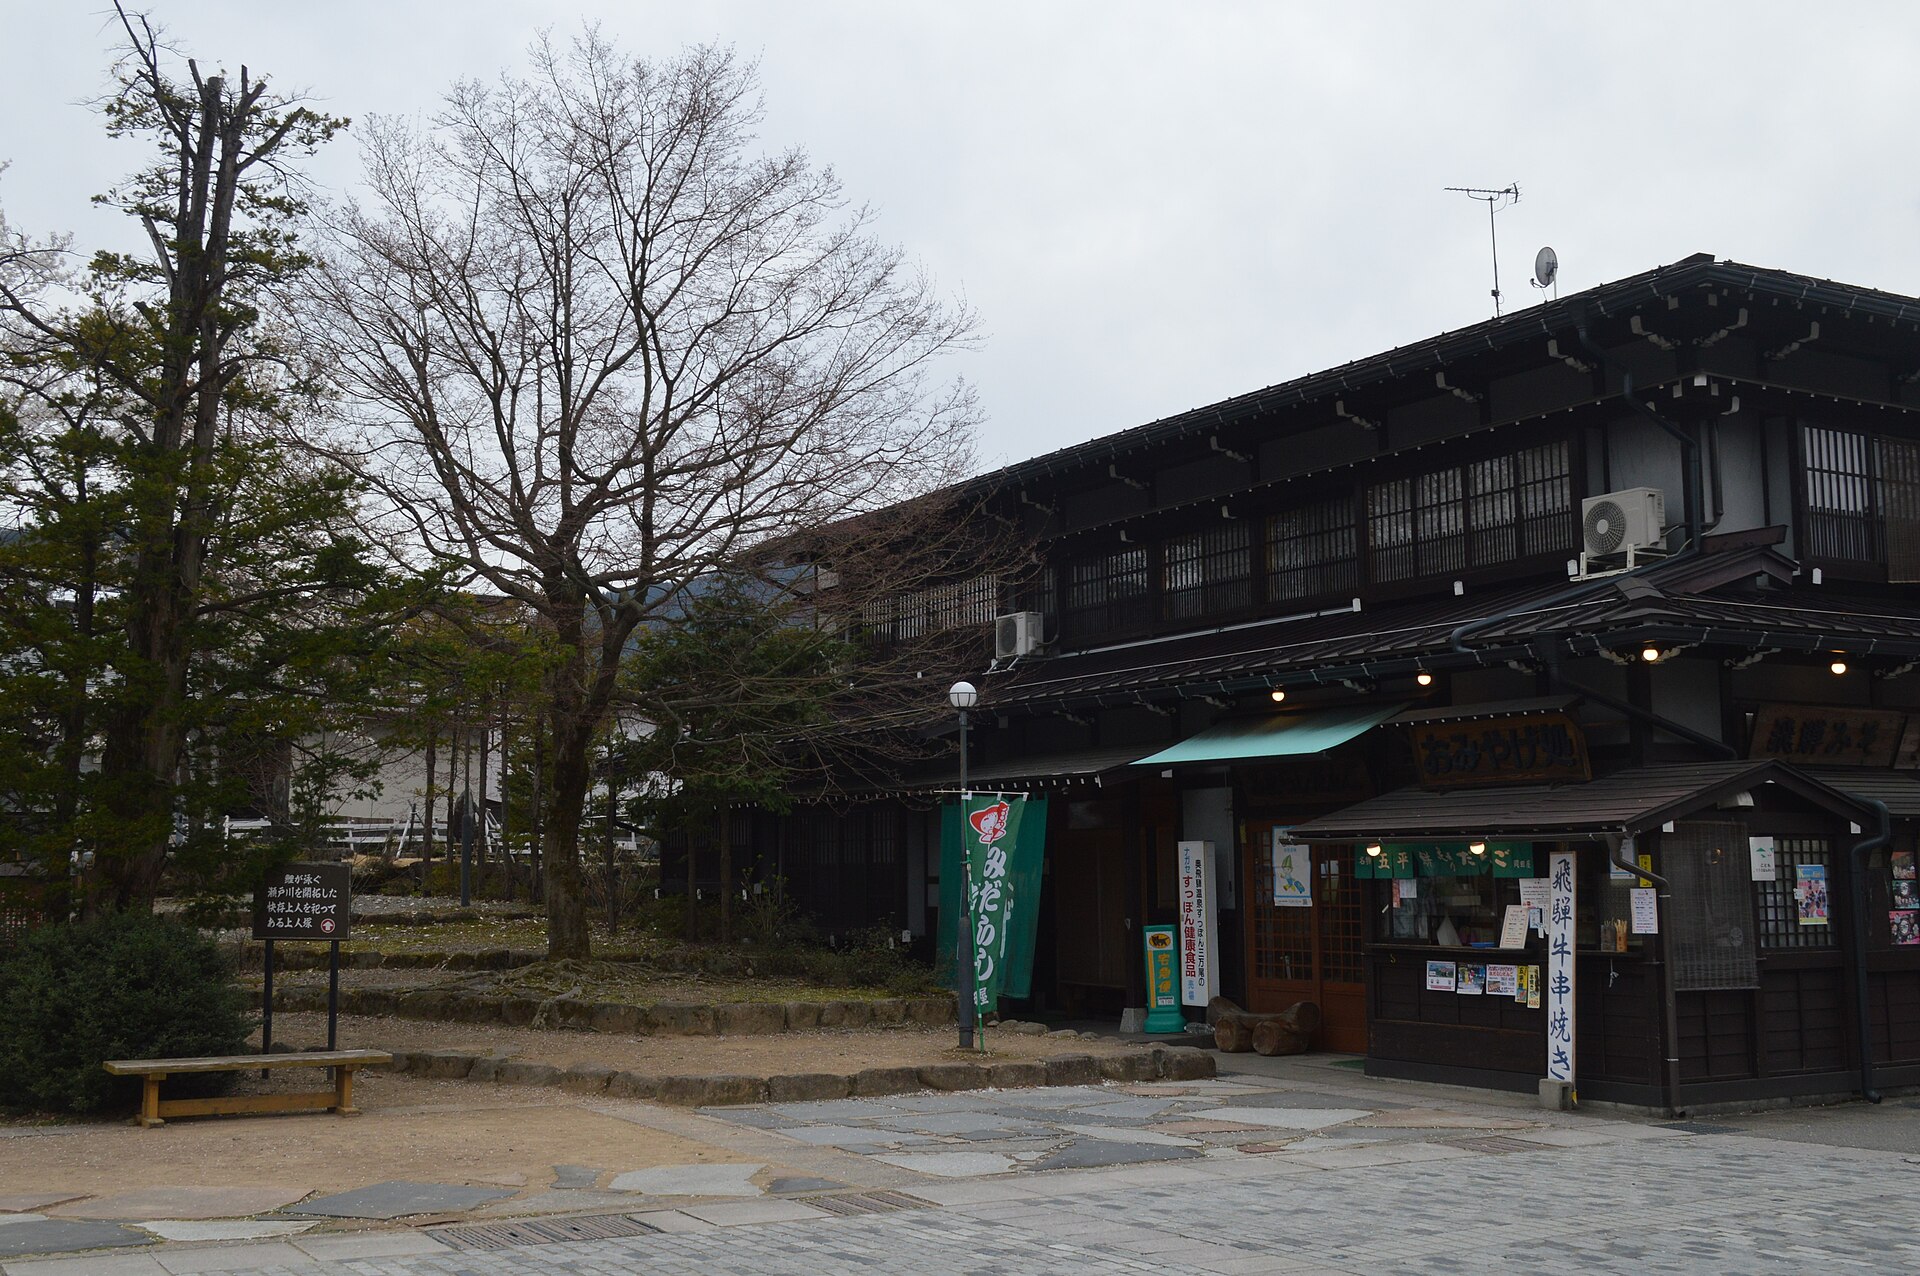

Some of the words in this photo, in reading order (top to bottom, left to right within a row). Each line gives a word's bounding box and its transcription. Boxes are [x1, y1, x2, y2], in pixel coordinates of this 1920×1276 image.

[1183, 848, 1192, 874] ナガセ
[284, 874, 322, 885] 鯉が泳ぐ
[267, 887, 338, 898] 瀬戸川を開拓した
[267, 917, 313, 929] ある上人塚
[1182, 875, 1197, 978] すっぽん健康食品
[1550, 858, 1573, 1080] 飛騨牛串焼き
